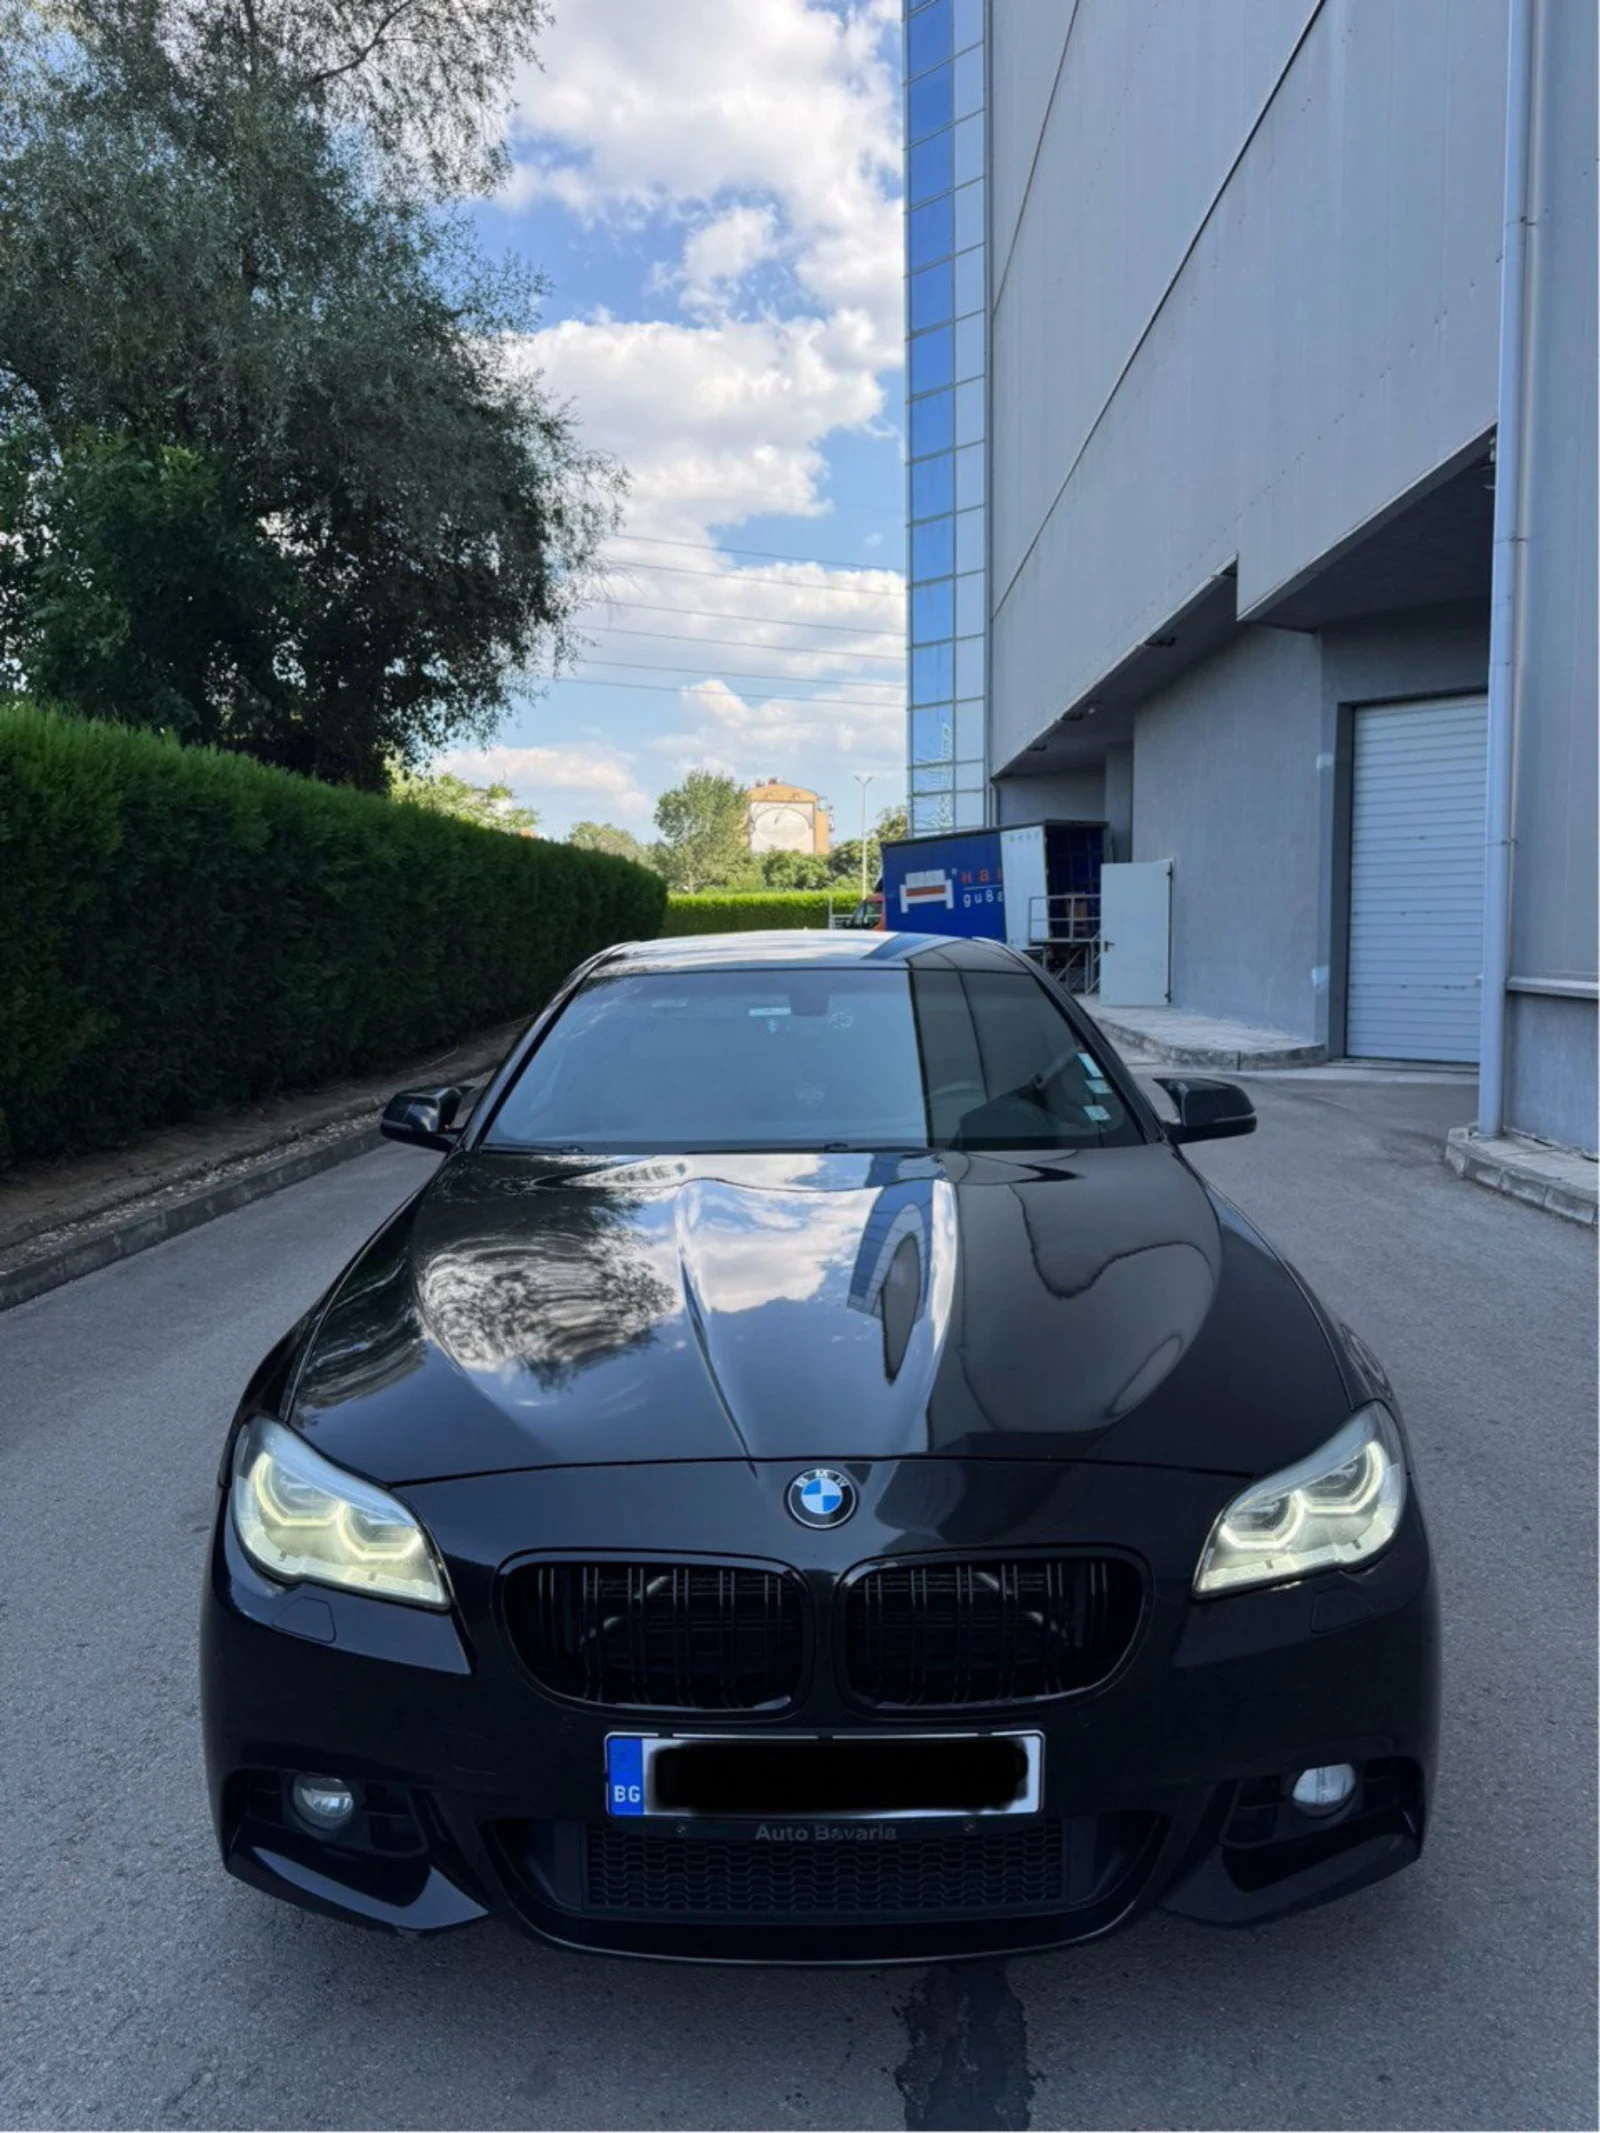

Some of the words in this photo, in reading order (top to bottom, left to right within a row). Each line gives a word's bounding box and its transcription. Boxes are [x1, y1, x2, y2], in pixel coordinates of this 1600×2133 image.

[794, 1468, 851, 1488] BMW
[614, 1785, 641, 1803] BG
[755, 1823, 808, 1841] Auto
[814, 1823, 897, 1841] Bavaria
